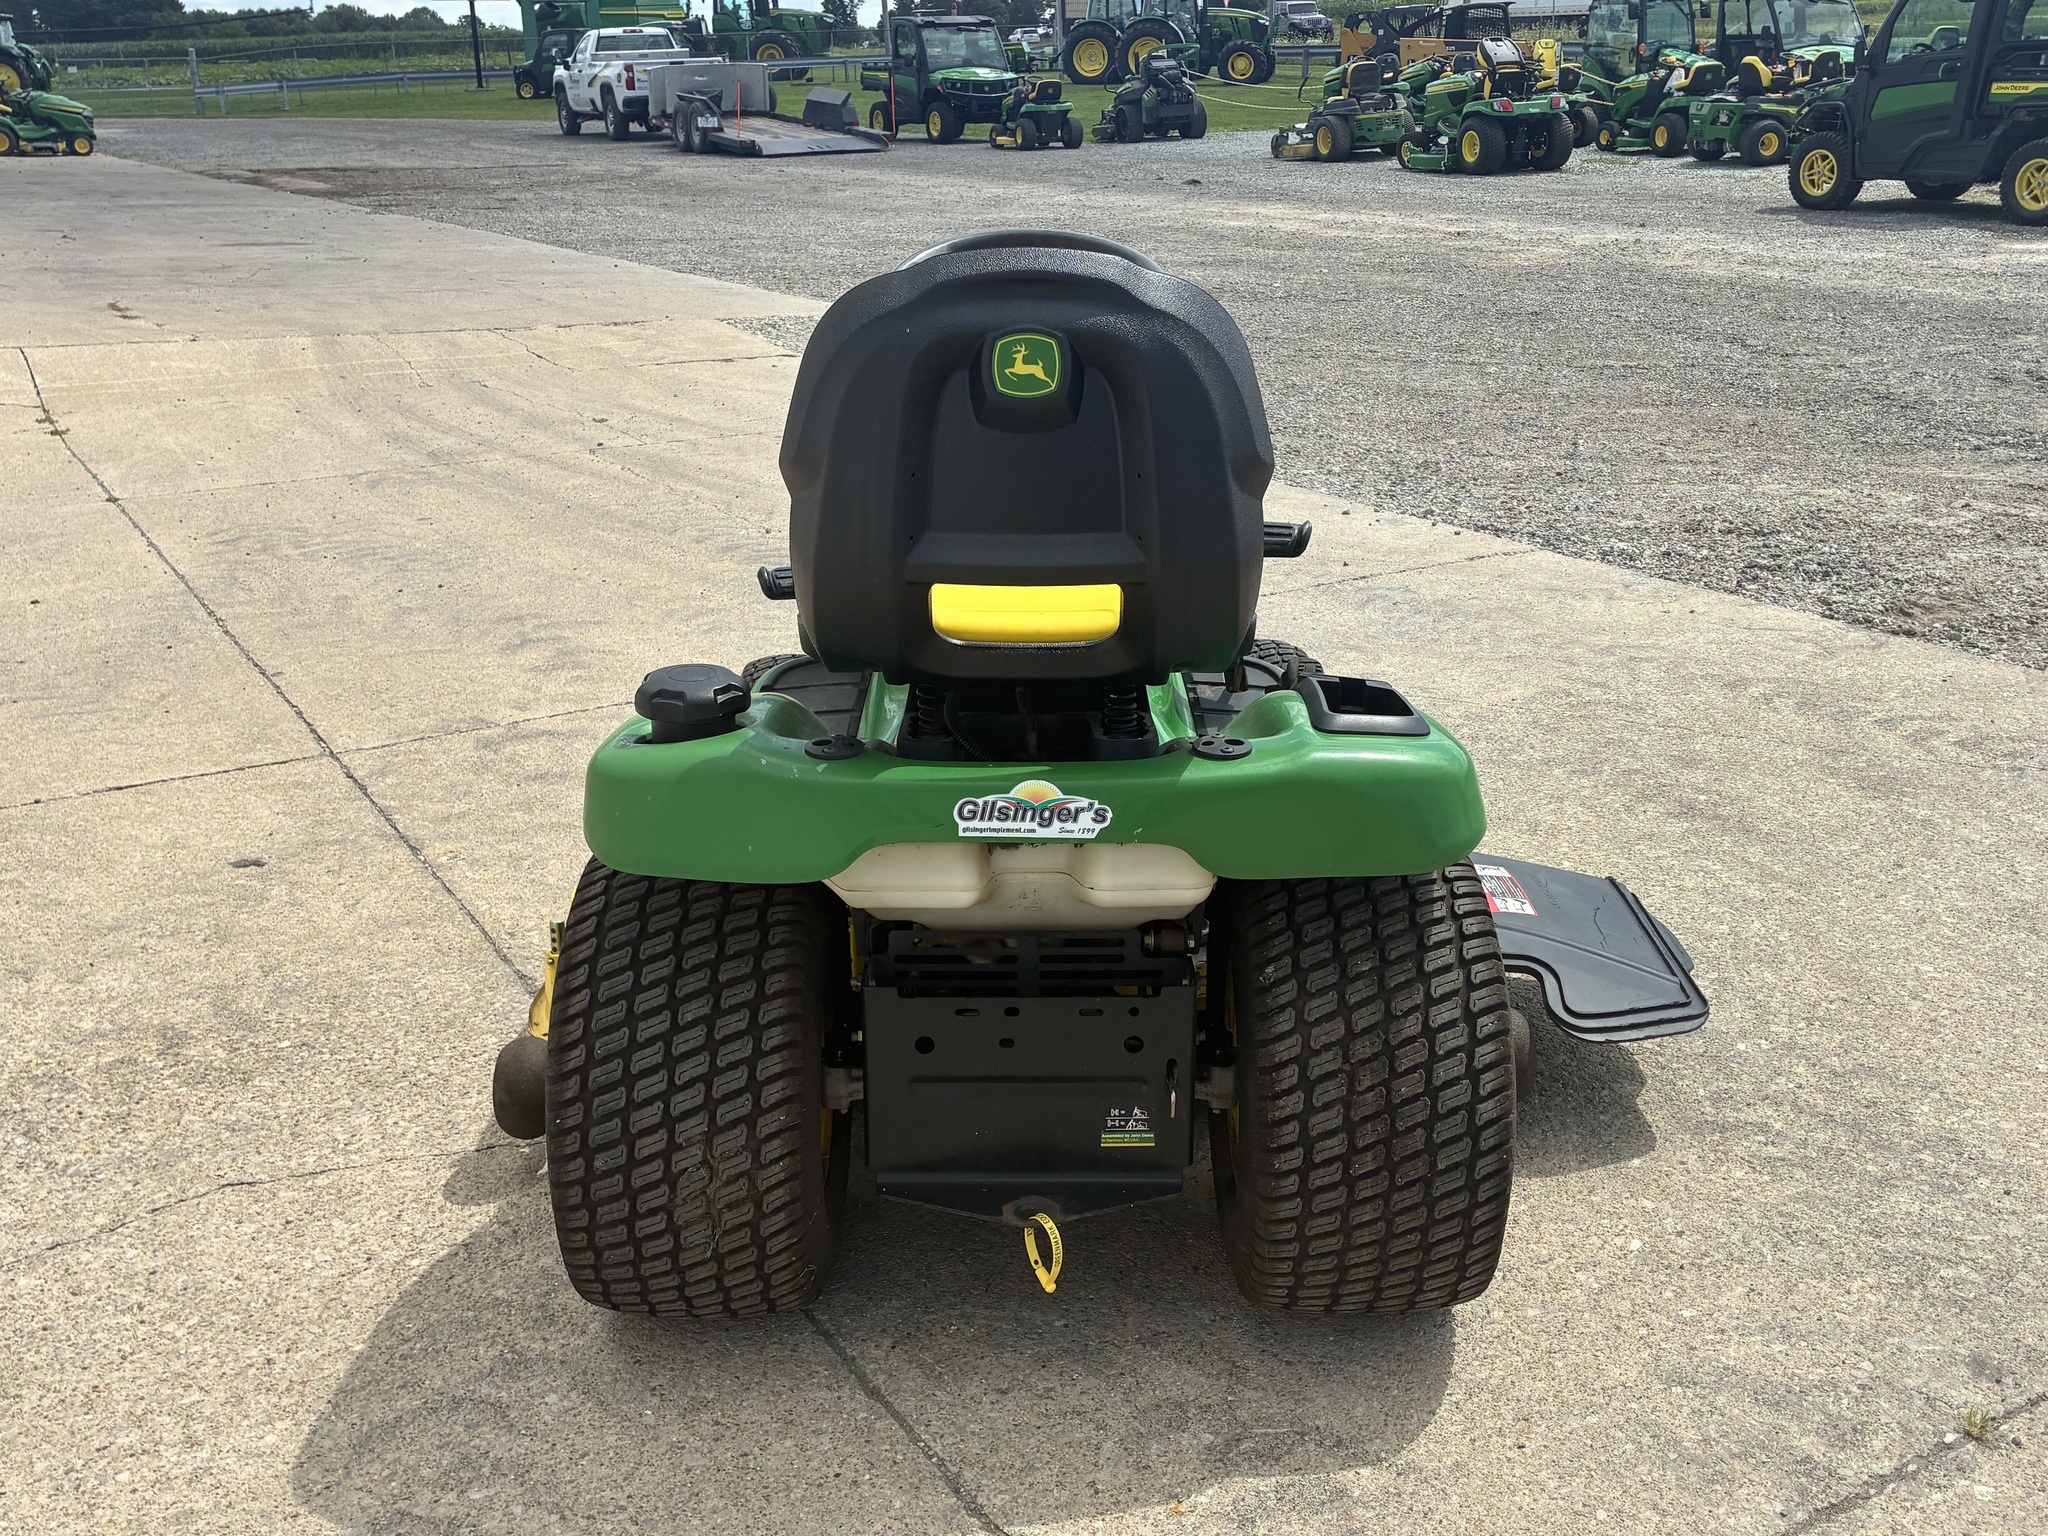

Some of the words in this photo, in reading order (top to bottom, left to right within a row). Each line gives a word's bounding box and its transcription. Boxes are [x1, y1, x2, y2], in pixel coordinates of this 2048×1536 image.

[957, 799, 1110, 829] Gilsinger's
[962, 826, 1037, 834] gilsingerimplement.com
[1058, 826, 1075, 834] Since
[1077, 827, 1096, 835] 1899
